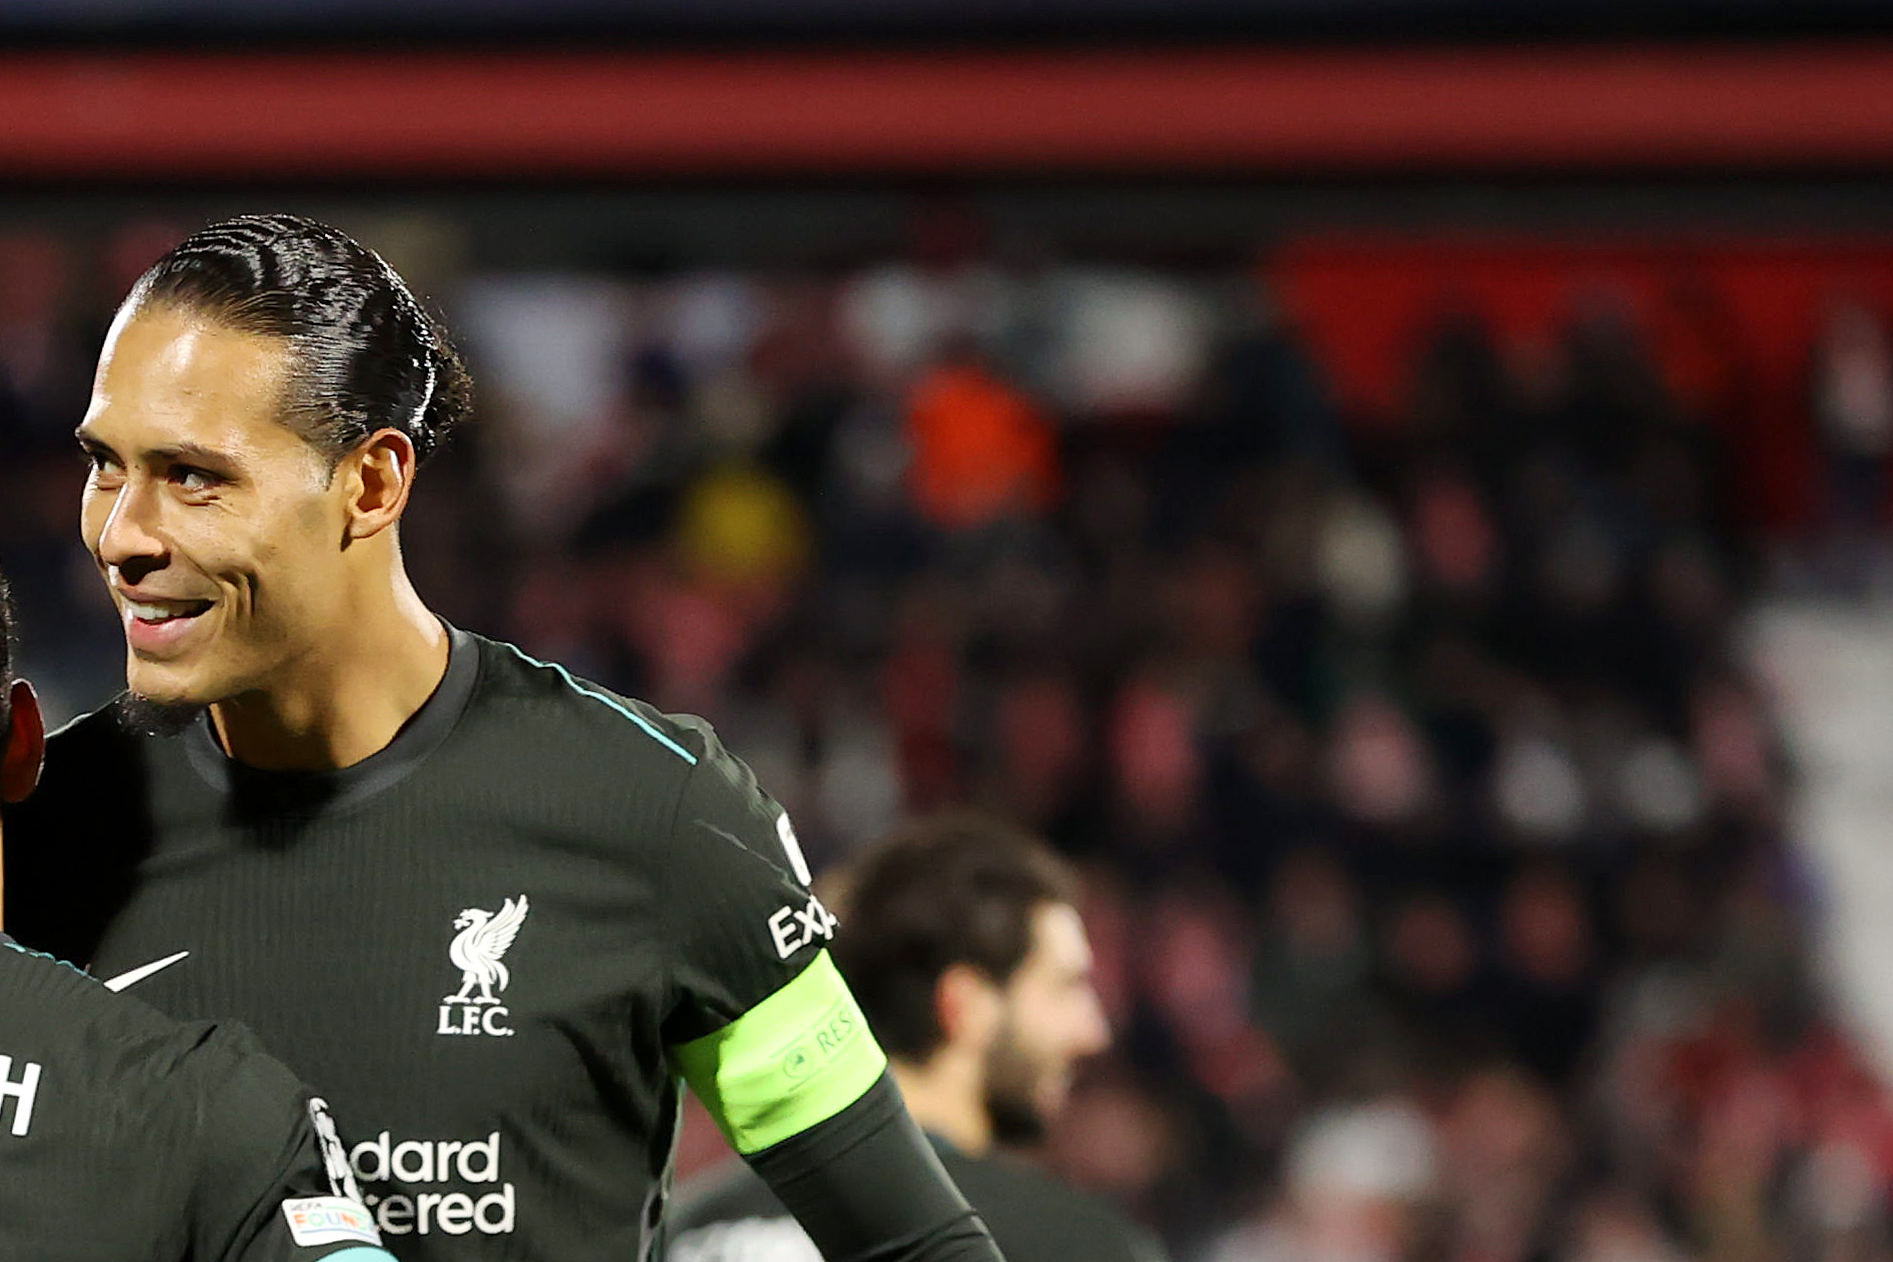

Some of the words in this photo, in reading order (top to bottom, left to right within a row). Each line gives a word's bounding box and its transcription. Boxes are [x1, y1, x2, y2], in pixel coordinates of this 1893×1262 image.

[816, 1003, 855, 1054] RES
[349, 1130, 501, 1184] dard
[365, 1182, 516, 1236] ered
